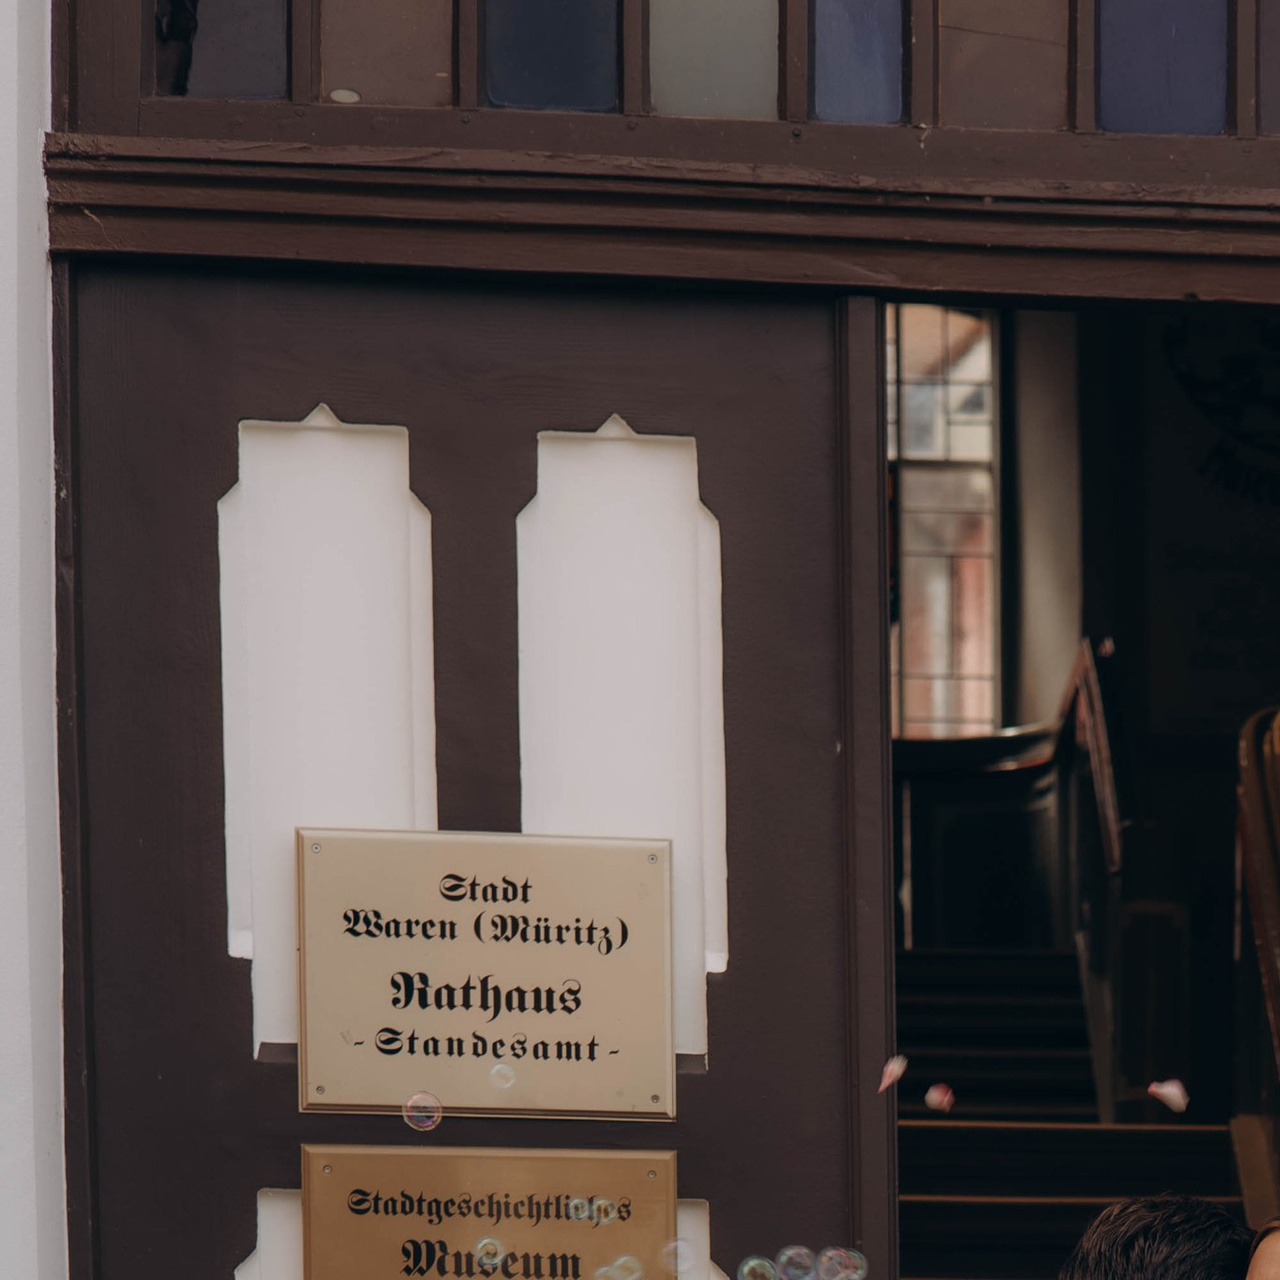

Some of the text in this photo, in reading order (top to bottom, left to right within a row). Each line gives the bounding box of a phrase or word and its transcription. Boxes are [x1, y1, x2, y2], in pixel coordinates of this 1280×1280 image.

[439, 873, 533, 904] Stadt
[342, 908, 629, 955] Waren (Müritz)
[390, 971, 582, 1023] Rathaus
[347, 1188, 632, 1227] Stadtgeschichtliches
[400, 1239, 582, 1280] Museum
